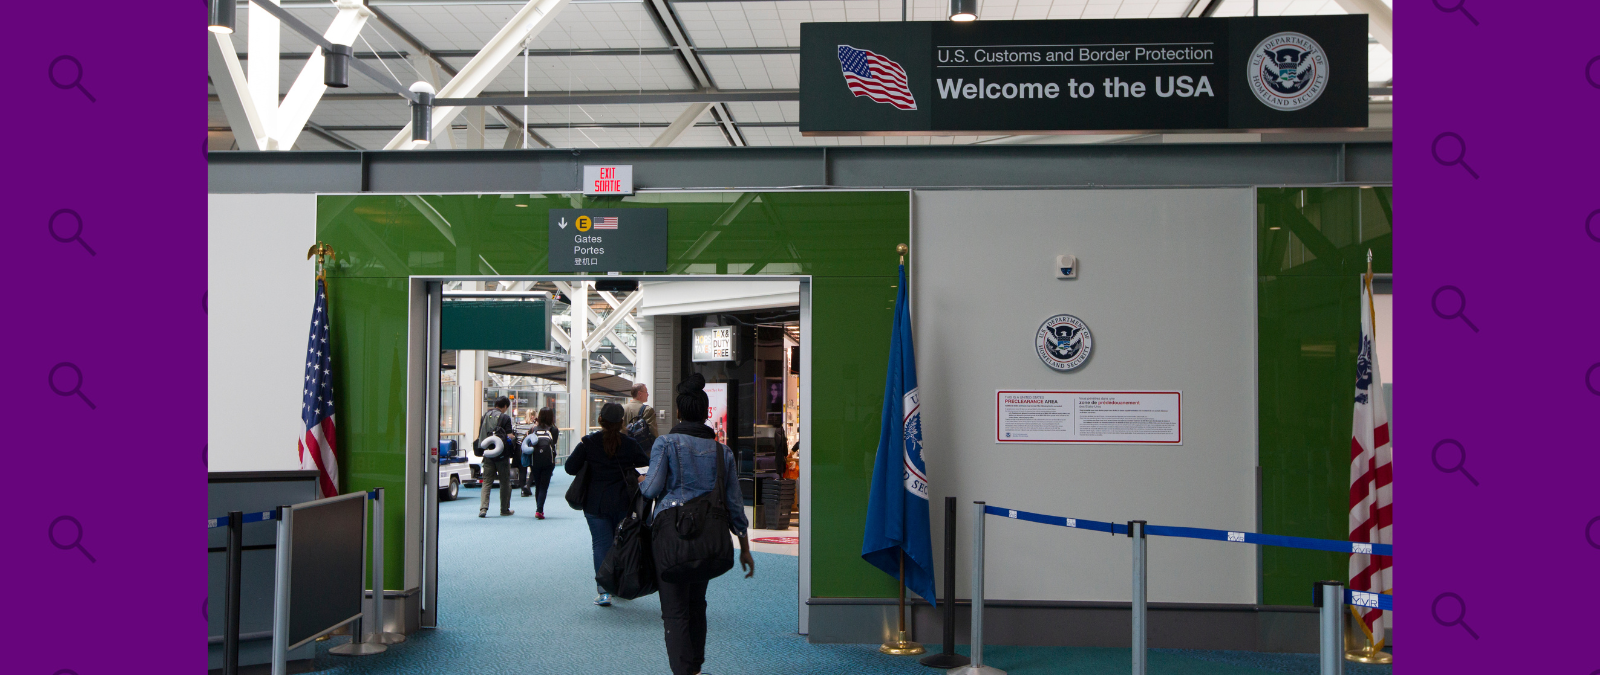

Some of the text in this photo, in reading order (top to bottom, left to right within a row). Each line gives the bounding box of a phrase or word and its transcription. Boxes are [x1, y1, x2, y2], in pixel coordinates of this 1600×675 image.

[938, 46, 1213, 63] U.S. Customs and Border Protection
[1265, 37, 1319, 55] DEPARTMENT
[1315, 55, 1323, 66] OF
[936, 75, 1214, 99] Welcome to the USA
[1252, 75, 1324, 106] HOMELAND SECURITY
[600, 167, 616, 179] EXIT
[594, 180, 621, 192] SORTIE
[579, 218, 588, 229] E
[574, 234, 603, 244] Gates
[574, 245, 605, 255] Portes
[574, 257, 598, 266] 登机口
[1047, 316, 1086, 331] DEPARTMENT
[713, 339, 730, 348] DUTY
[713, 348, 729, 358] FREE
[1038, 345, 1090, 369] HOMELAND SECURITY
[1352, 546, 1372, 554] YVR
[1352, 595, 1378, 608] YVR
